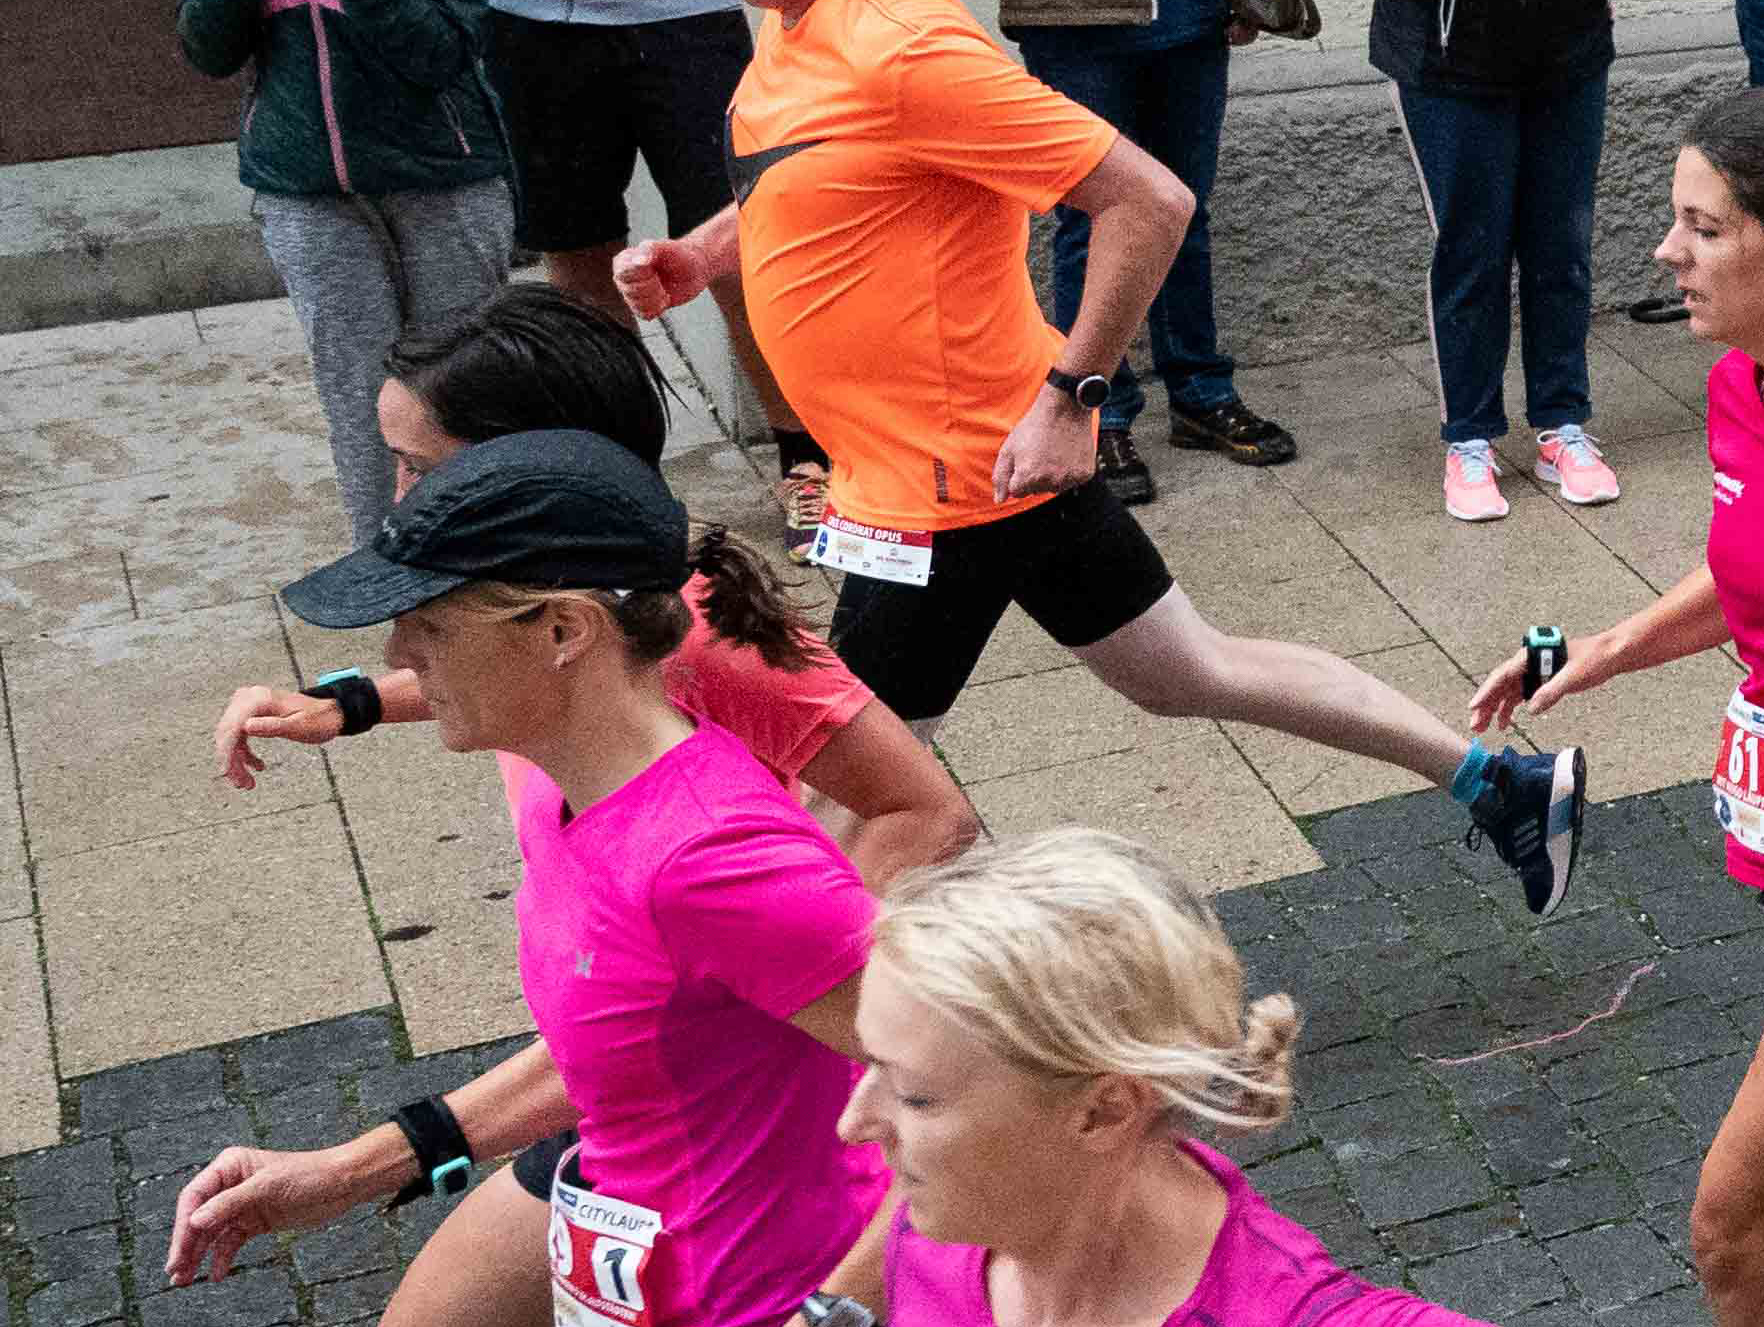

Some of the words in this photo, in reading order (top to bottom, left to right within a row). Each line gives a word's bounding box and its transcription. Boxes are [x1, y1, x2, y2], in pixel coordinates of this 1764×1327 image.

[875, 528, 902, 542] OPUS
[1728, 728, 1759, 793] 61
[602, 1247, 629, 1303] 1
